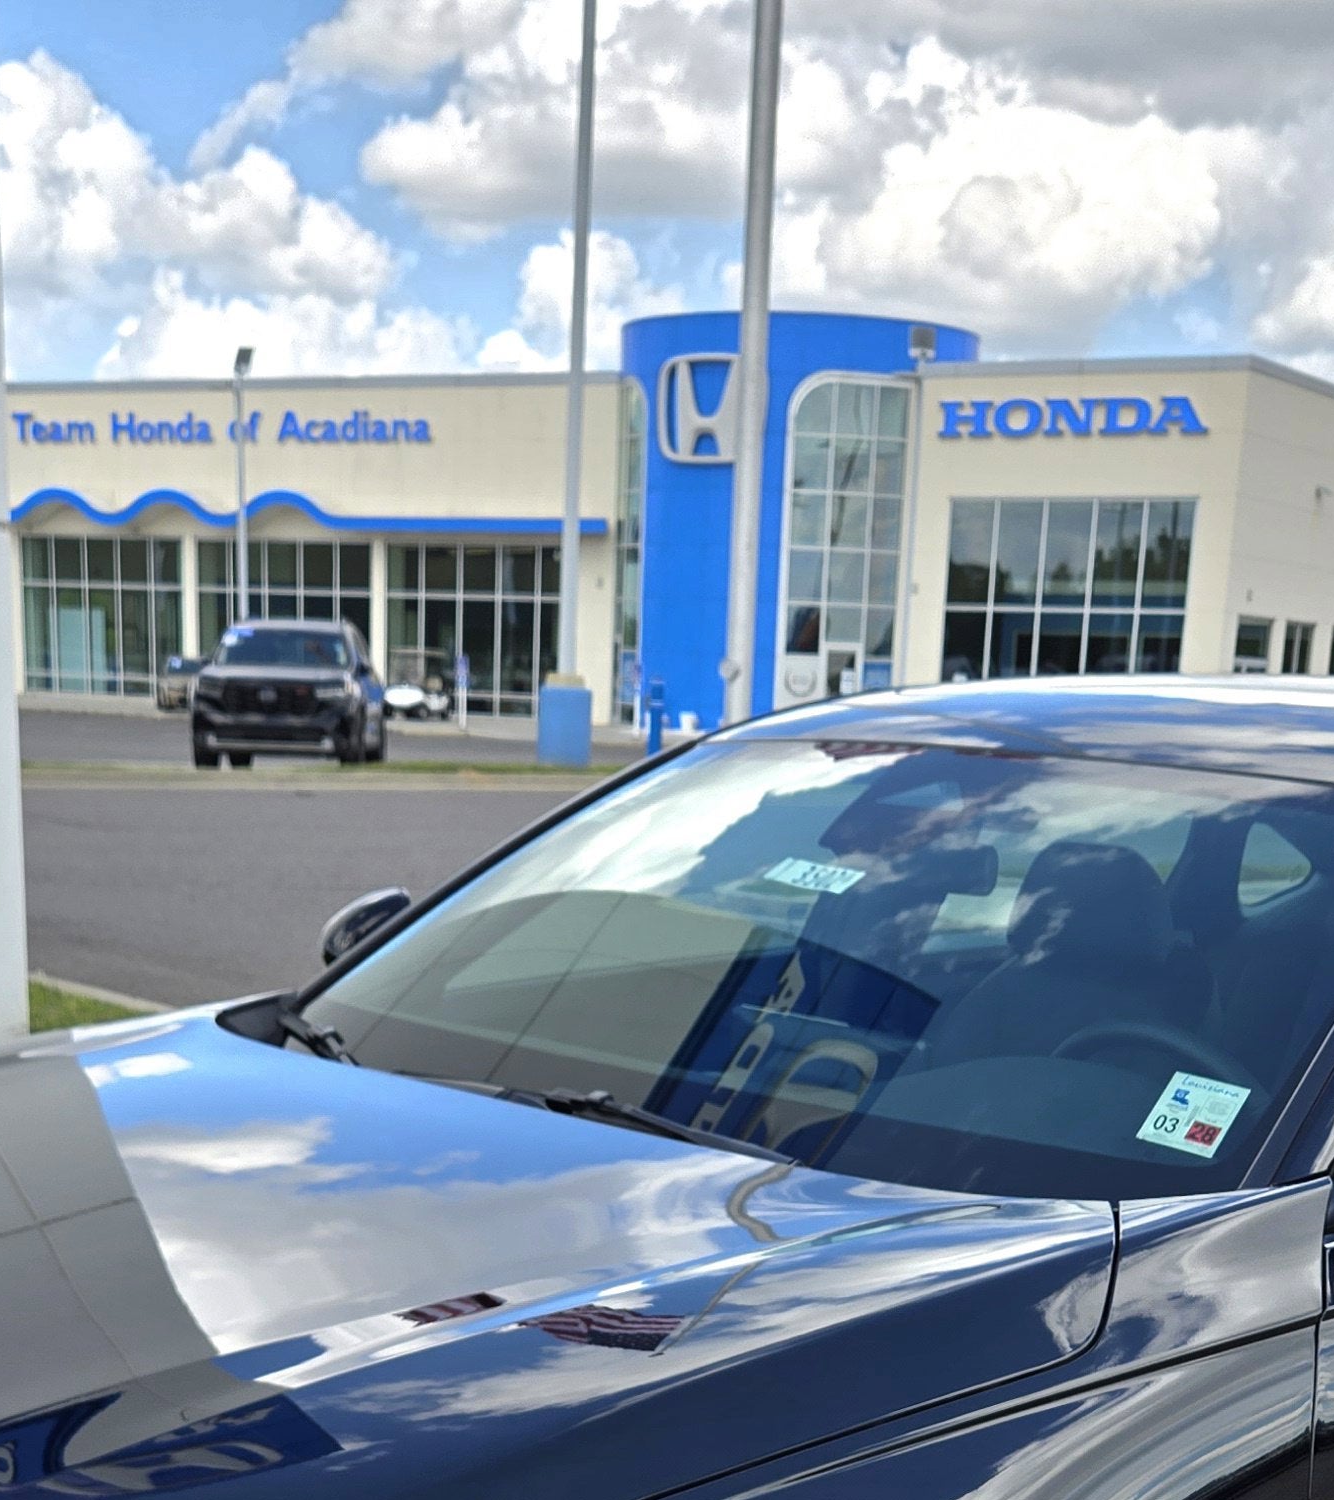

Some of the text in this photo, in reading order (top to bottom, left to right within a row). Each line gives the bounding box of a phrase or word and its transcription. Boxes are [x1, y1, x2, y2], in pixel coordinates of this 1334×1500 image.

[12, 409, 431, 444] Team Honda of Acadiana
[938, 395, 1208, 440] HONDA
[1182, 1075, 1240, 1099] Louisiana
[1153, 1114, 1180, 1133] 03
[1189, 1121, 1218, 1146] 28
